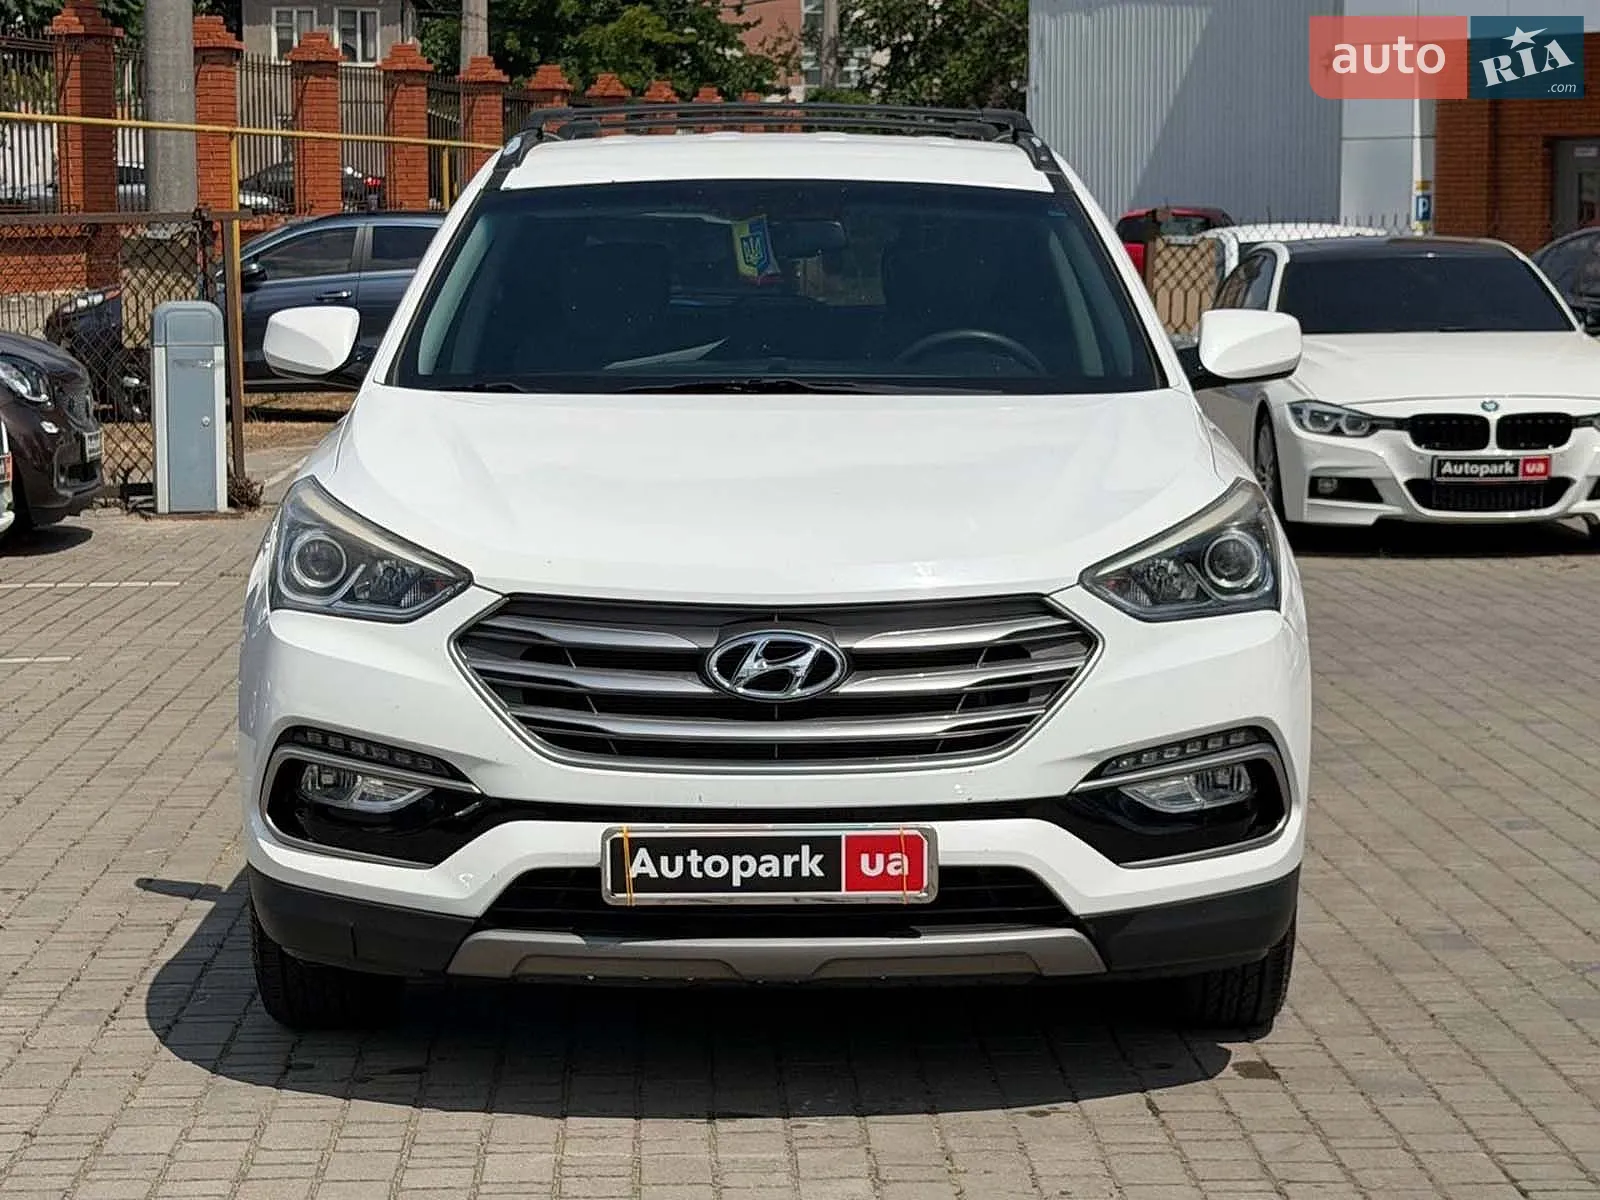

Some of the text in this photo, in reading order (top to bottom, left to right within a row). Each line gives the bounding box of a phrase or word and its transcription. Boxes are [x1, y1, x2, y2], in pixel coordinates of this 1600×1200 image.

[1418, 197, 1429, 220] P
[1441, 461, 1545, 477] Autopark ua
[629, 844, 909, 887] Autopark ua
